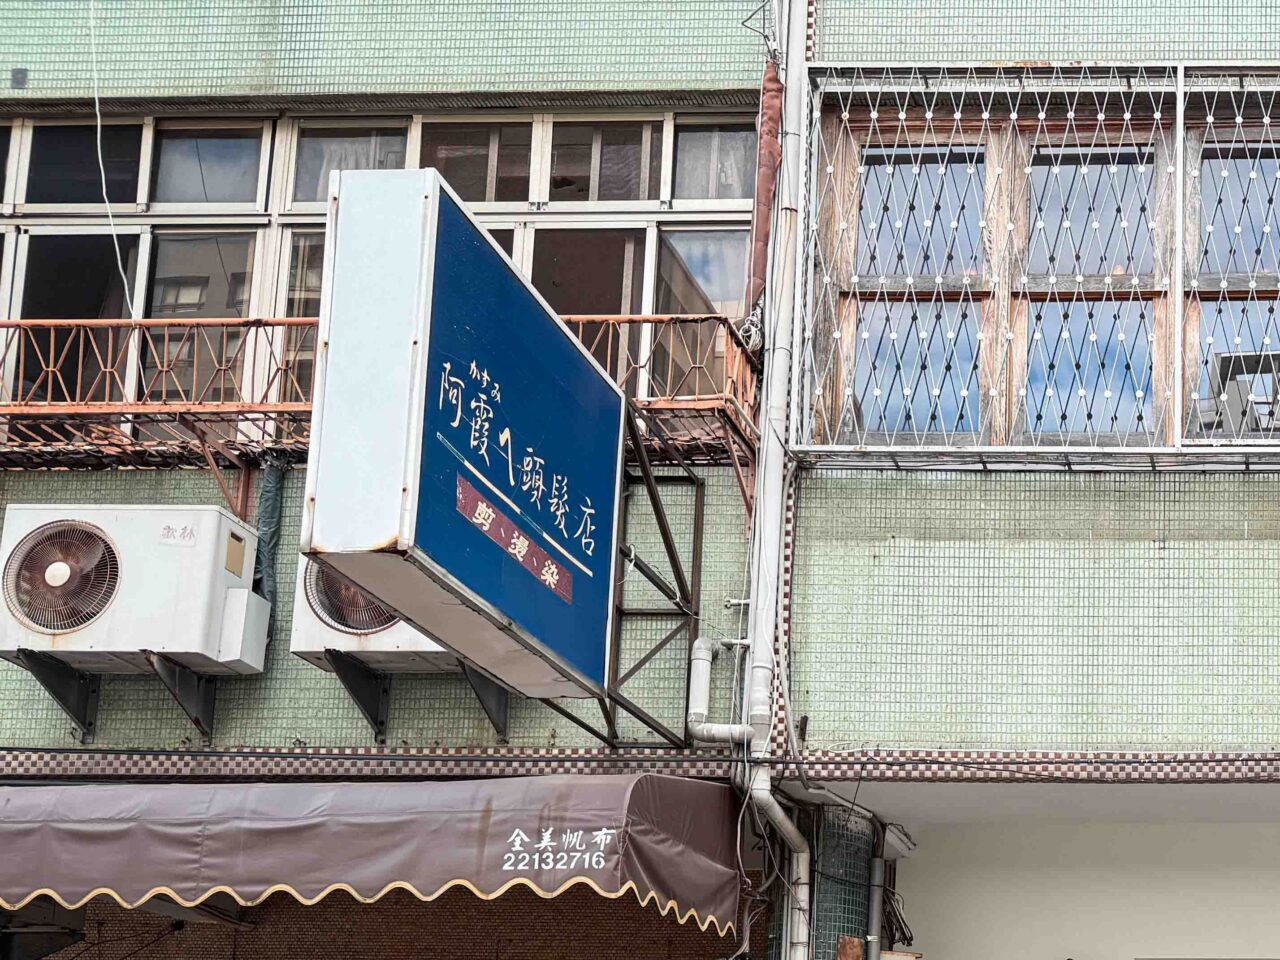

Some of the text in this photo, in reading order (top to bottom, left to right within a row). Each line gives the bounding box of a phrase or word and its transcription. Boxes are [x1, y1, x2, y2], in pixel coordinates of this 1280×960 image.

[506, 828, 616, 851] 全美帆布
[502, 852, 606, 871] 22132716
